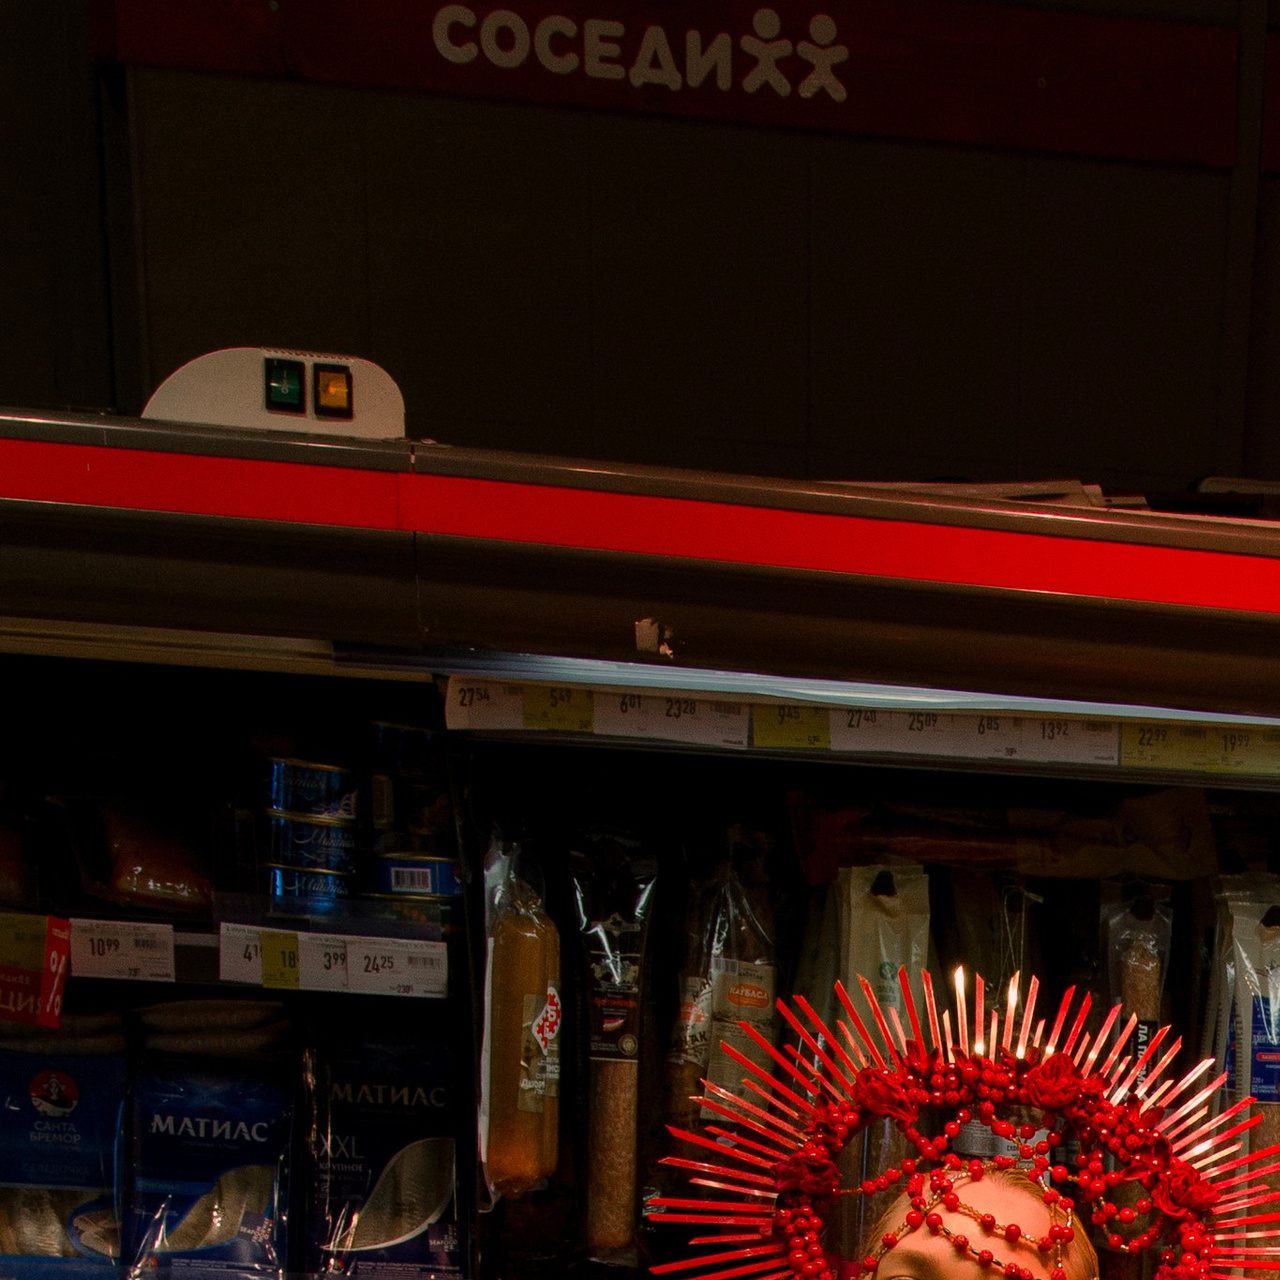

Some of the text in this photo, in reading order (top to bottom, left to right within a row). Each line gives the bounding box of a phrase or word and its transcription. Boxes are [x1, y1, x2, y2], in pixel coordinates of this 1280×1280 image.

[432, 3, 732, 92] СОСЕДИ
[331, 1083, 446, 1107] МАТИАС
[29, 1132, 82, 1145] БРЕМОР
[33, 1121, 77, 1133] САНТА
[150, 1113, 269, 1142] МАТИАС
[319, 1133, 365, 1159] XXL
